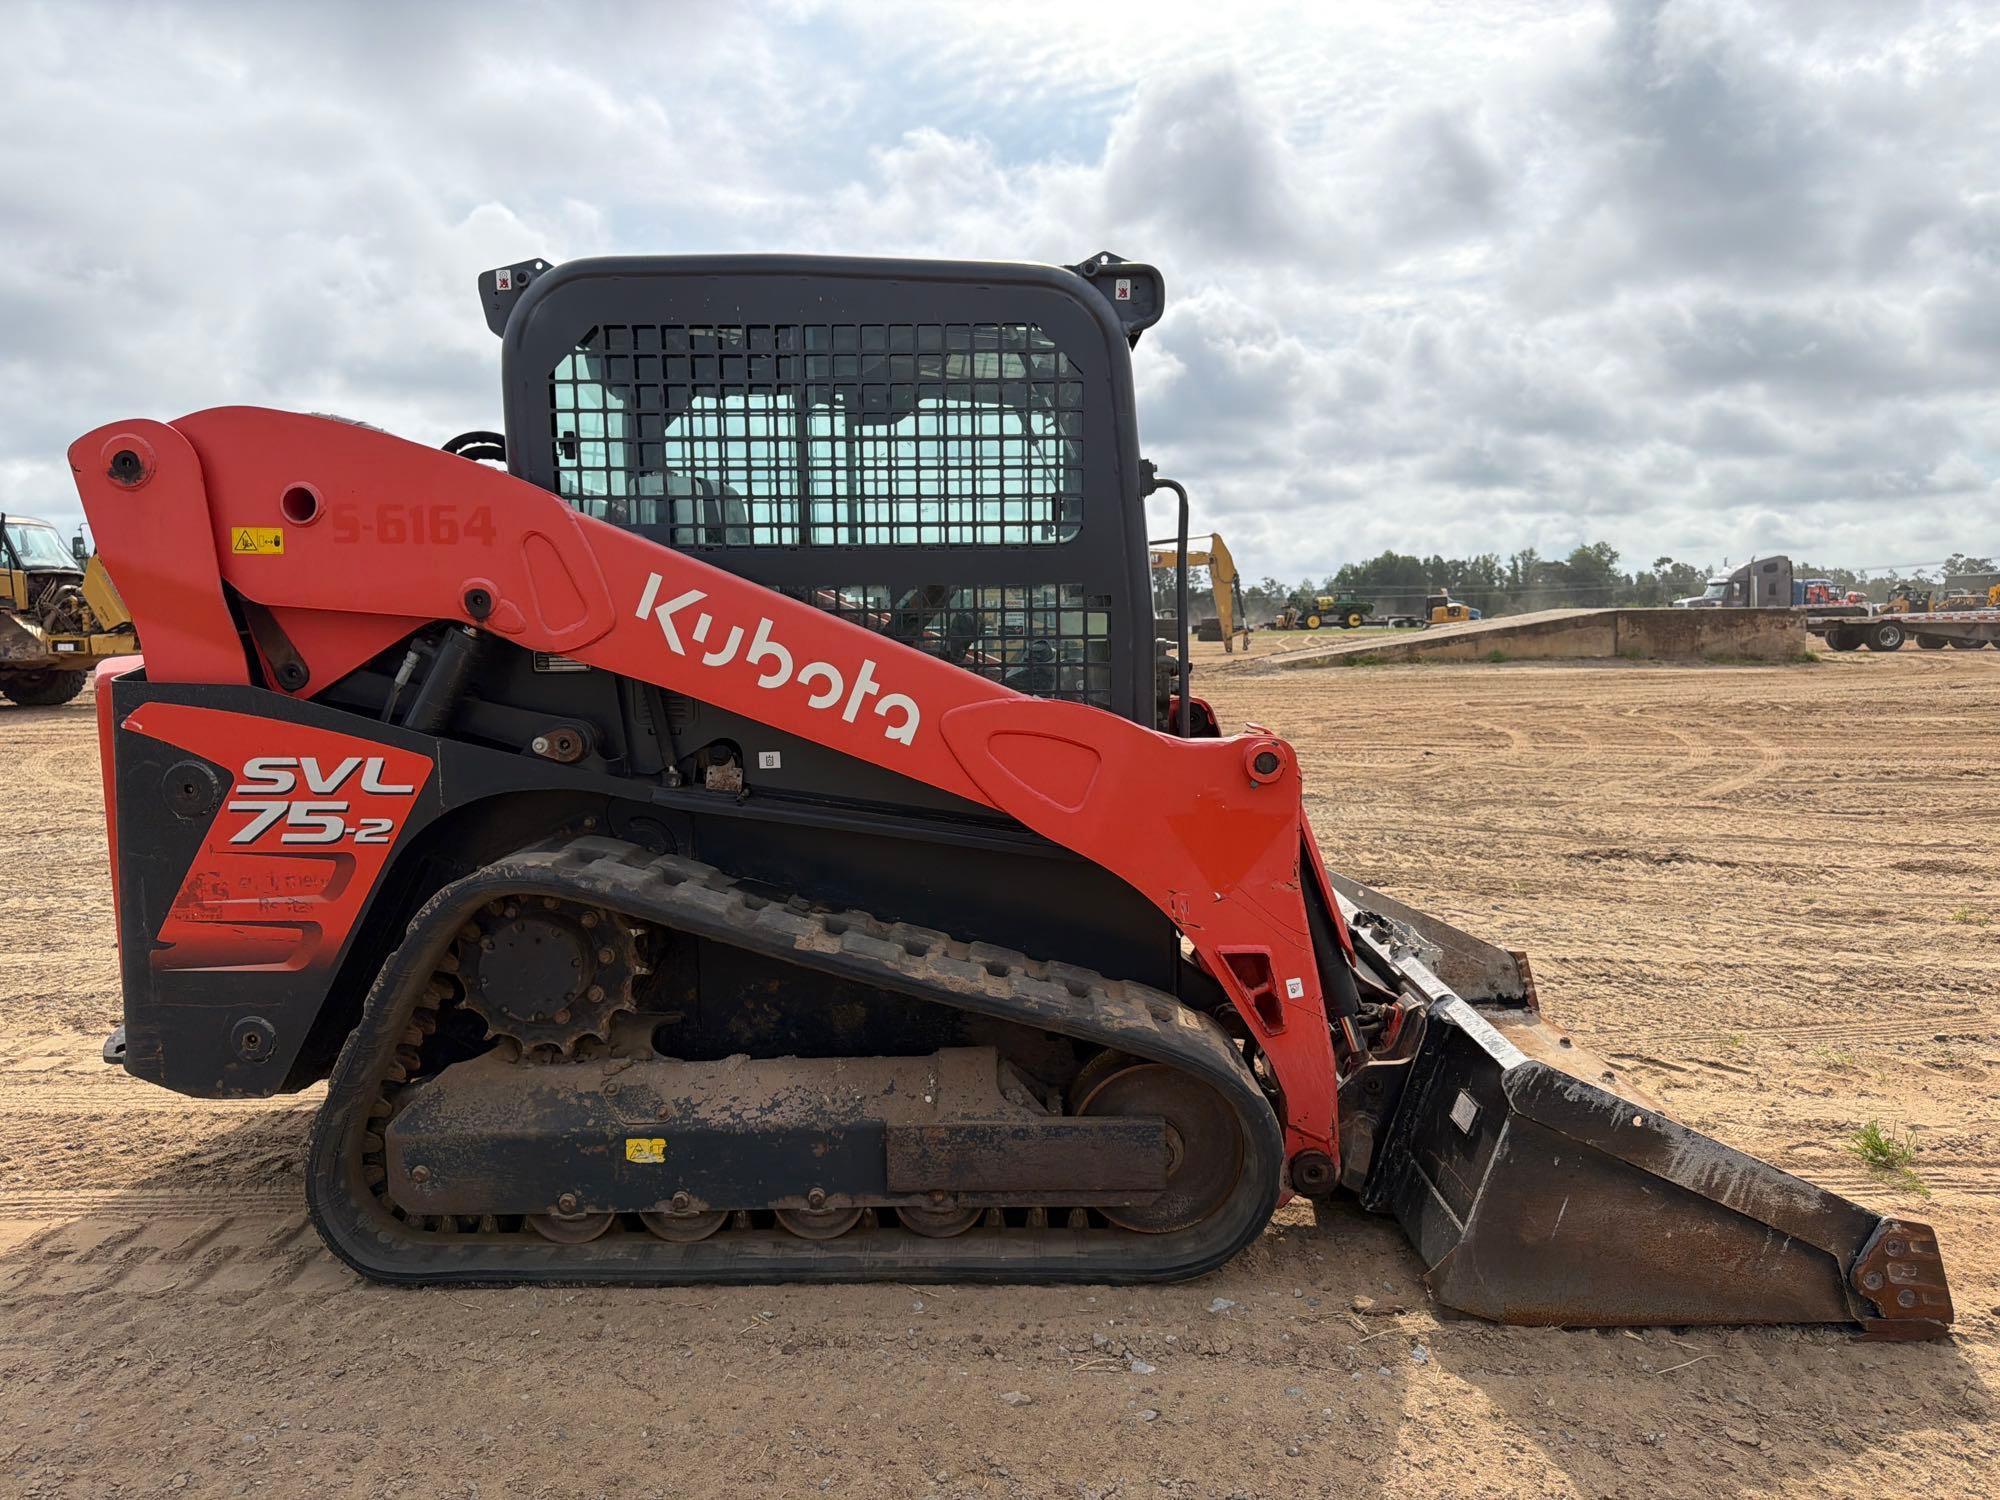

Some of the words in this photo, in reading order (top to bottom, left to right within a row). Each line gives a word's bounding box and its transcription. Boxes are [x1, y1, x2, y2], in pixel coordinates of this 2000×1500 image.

[635, 572, 920, 746] Kubota
[236, 757, 415, 796] SVL
[227, 801, 395, 845] 75-2
